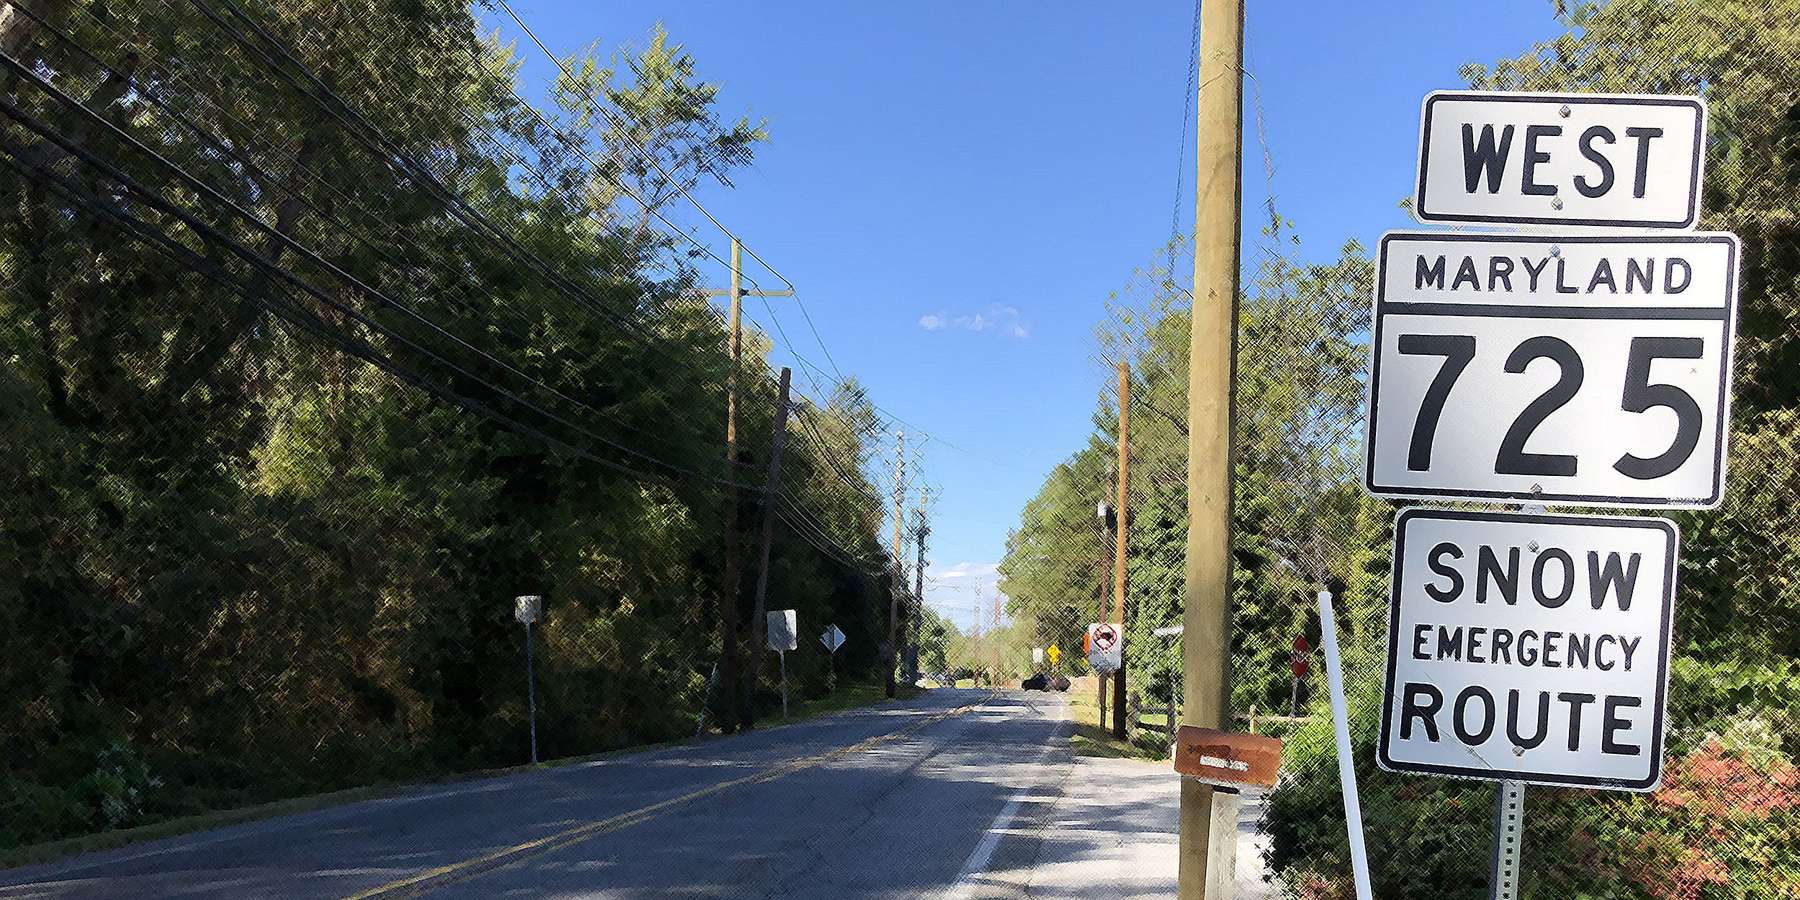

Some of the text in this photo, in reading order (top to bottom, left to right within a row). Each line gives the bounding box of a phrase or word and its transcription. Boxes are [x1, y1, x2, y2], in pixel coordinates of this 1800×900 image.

[1461, 123, 1663, 198] WEST
[1415, 254, 1692, 294] MARYLAND
[1398, 335, 1704, 480] 725
[1423, 542, 1641, 611] SNOW
[1413, 624, 1642, 672] EMERGENCY
[1400, 682, 1641, 756] ROUTE
